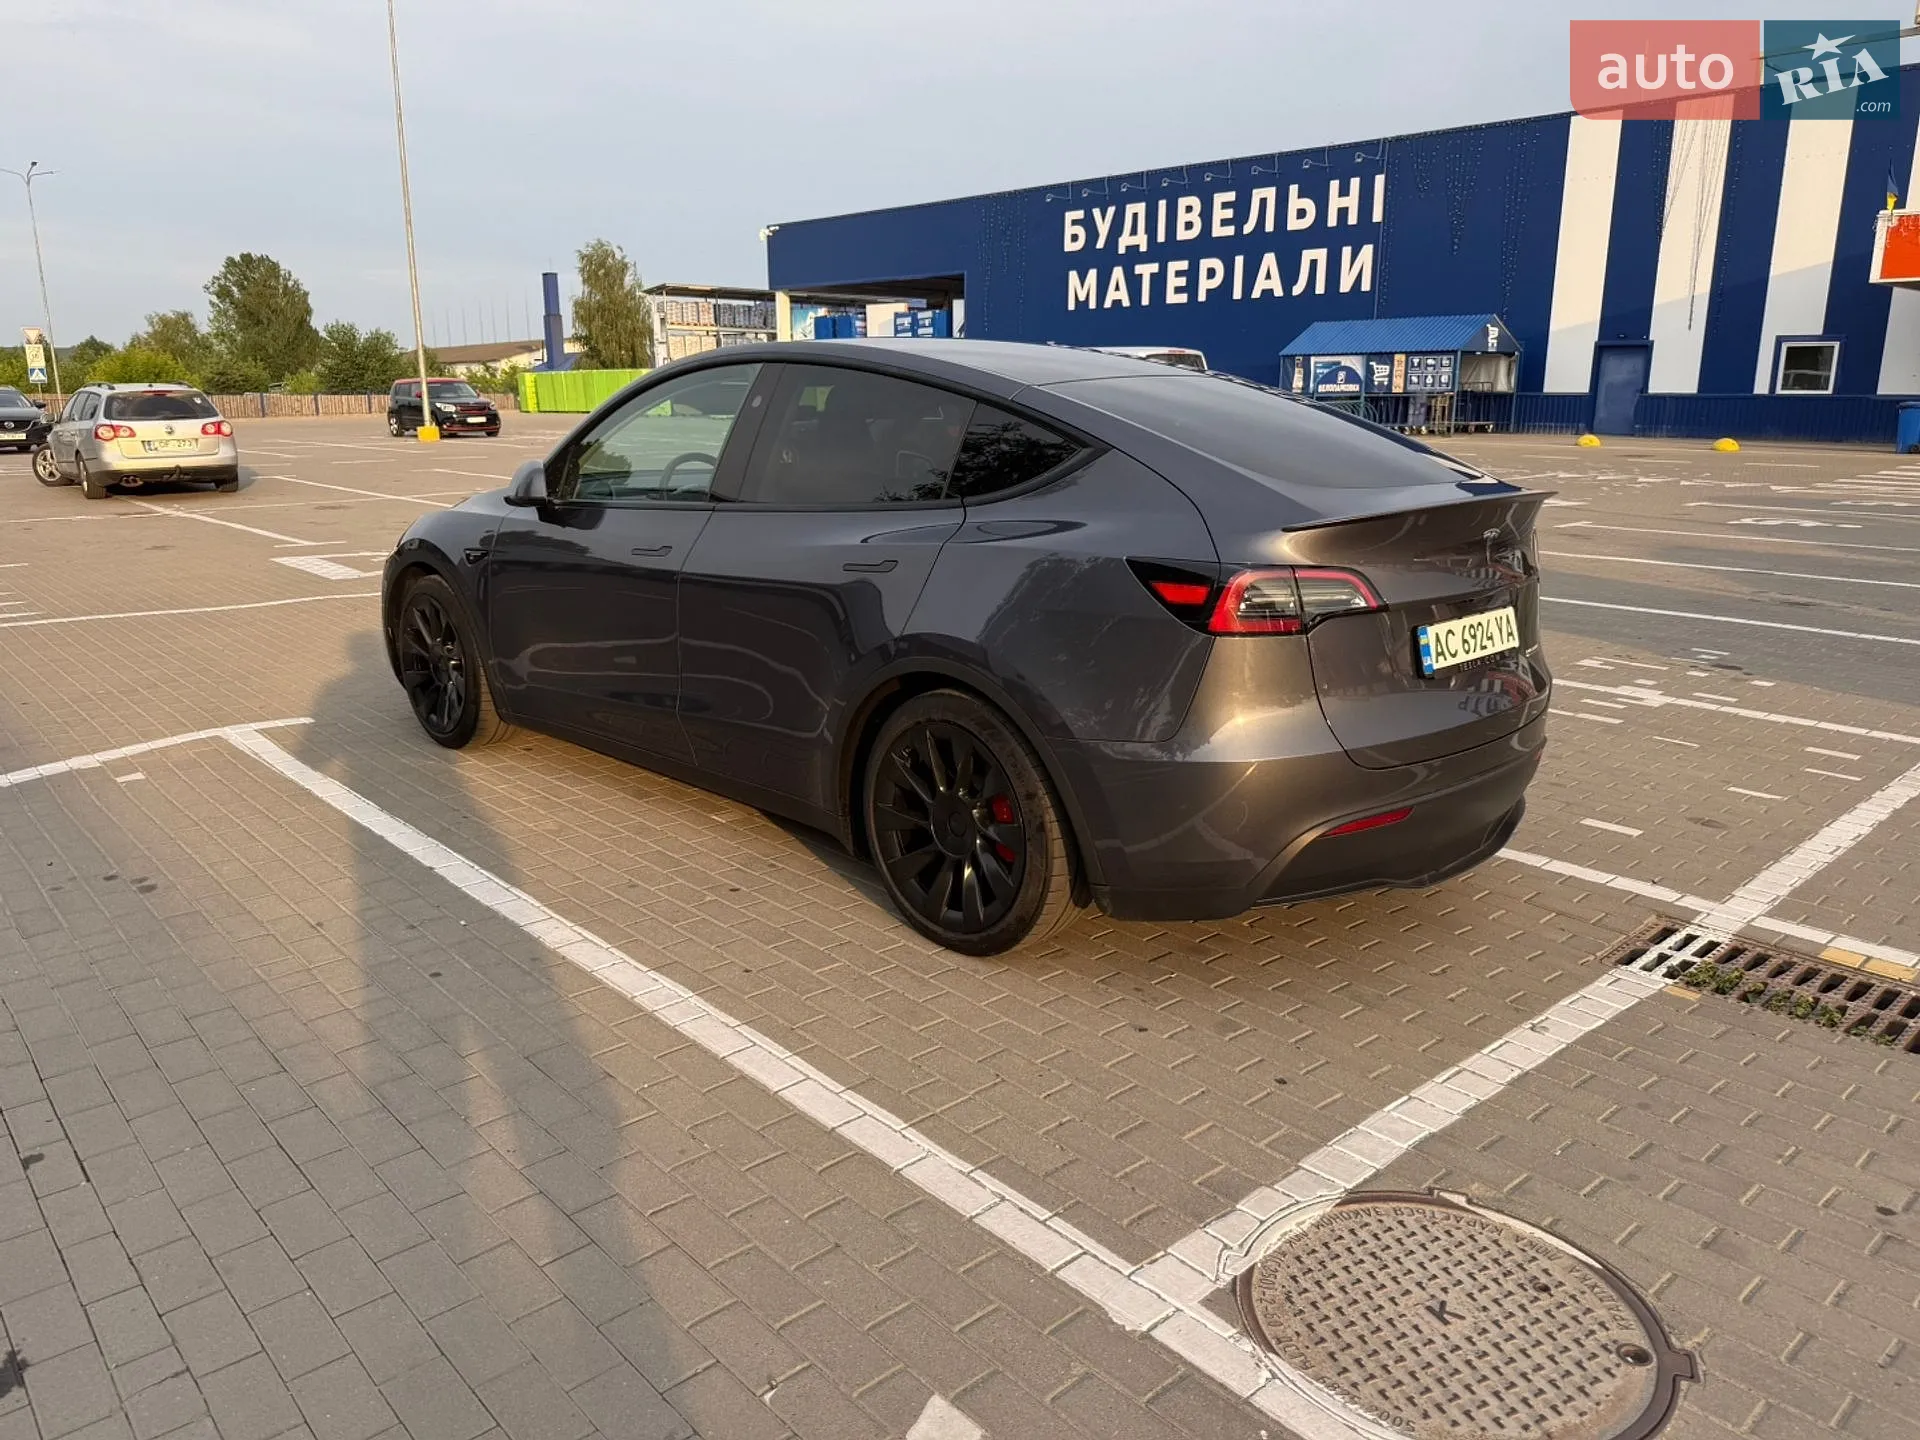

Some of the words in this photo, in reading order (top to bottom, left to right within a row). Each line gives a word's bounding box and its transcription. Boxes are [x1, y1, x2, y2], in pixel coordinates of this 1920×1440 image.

[1064, 174, 1385, 254] БУДІВЕЛЬНІ
[1067, 244, 1374, 311] МАТЕРІАЛИ
[1435, 629, 1458, 663] AC
[1461, 619, 1495, 655] 6924
[1494, 614, 1516, 645] YA
